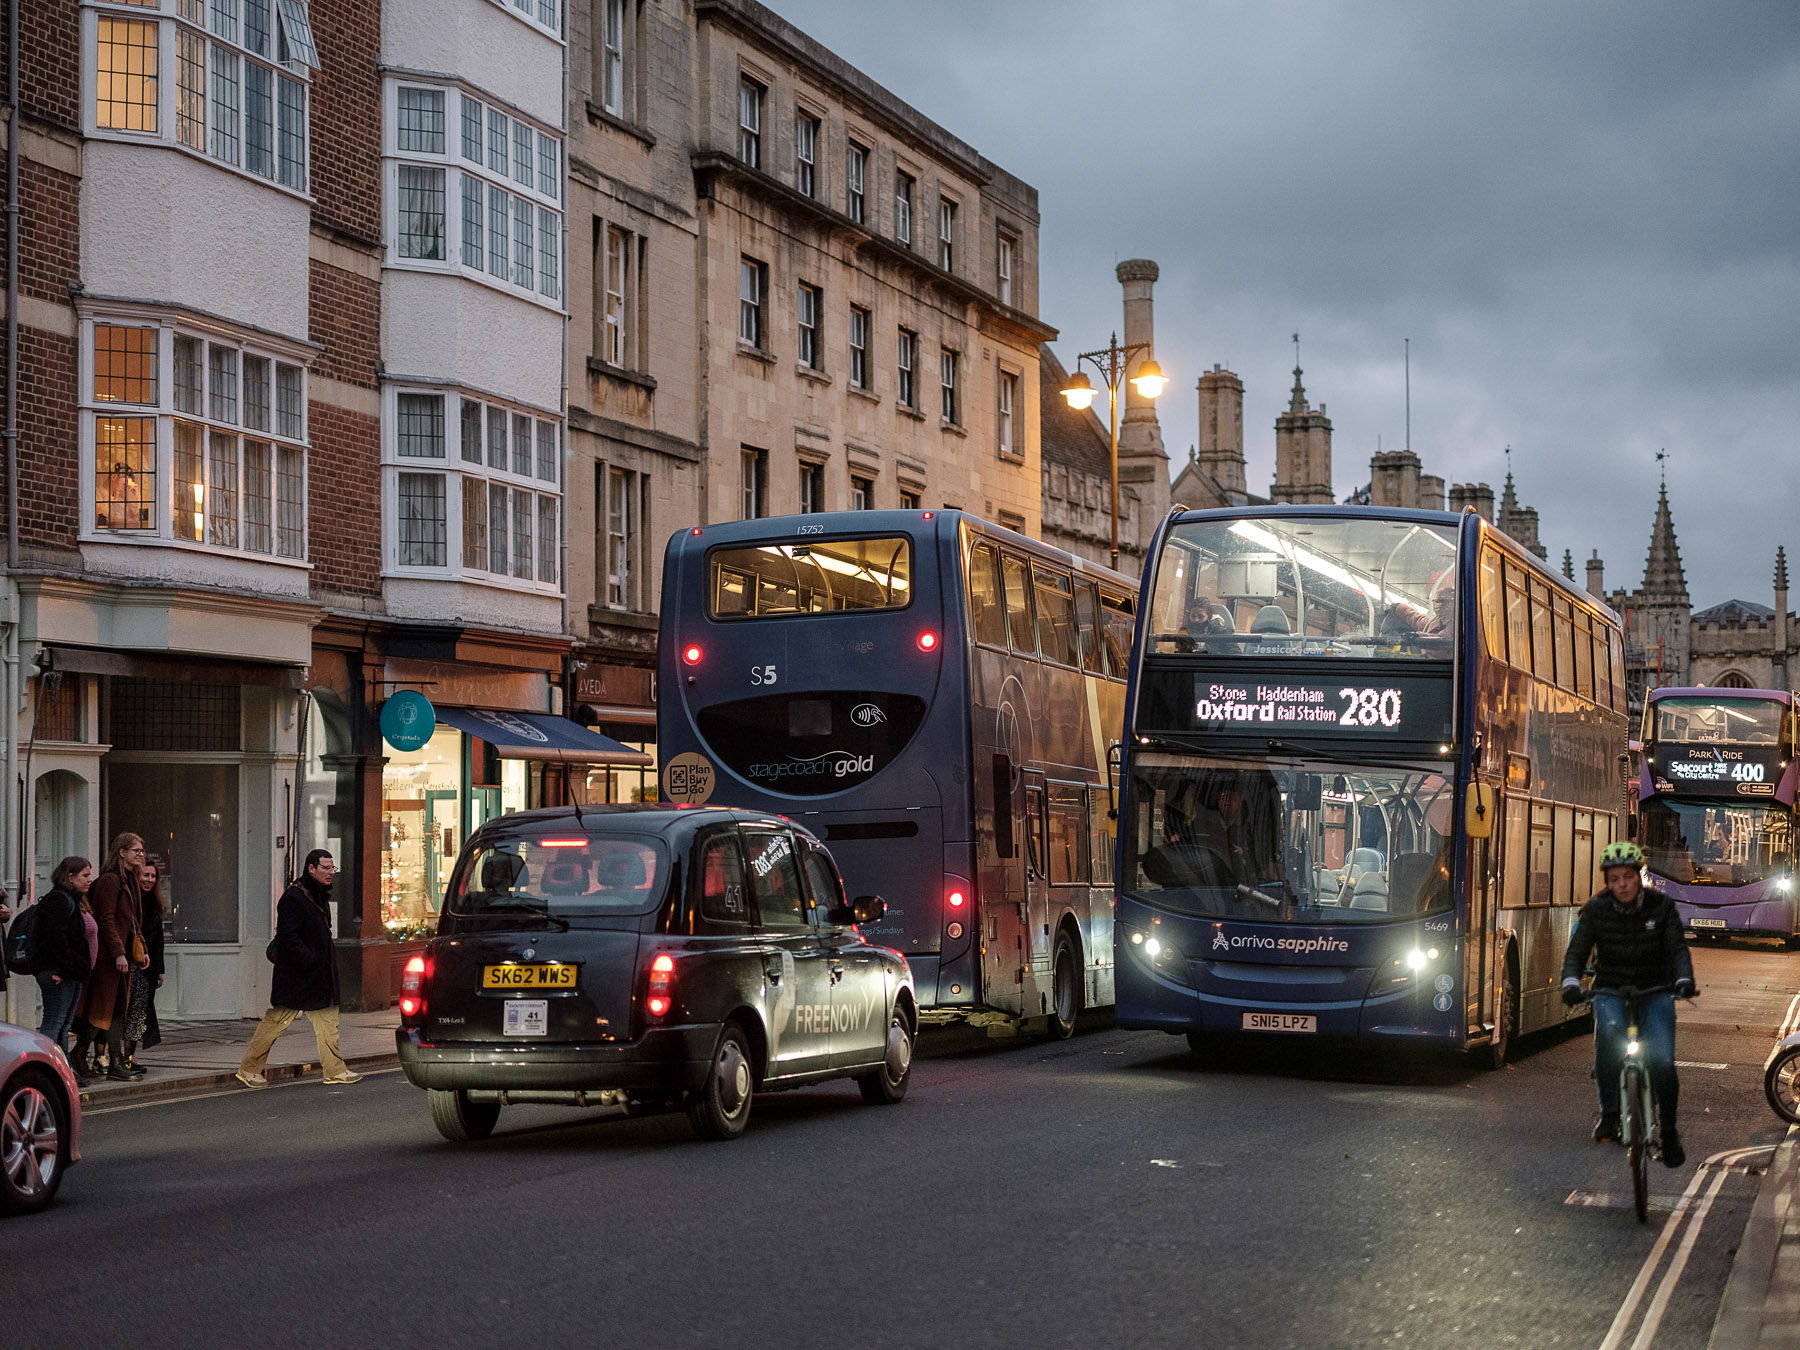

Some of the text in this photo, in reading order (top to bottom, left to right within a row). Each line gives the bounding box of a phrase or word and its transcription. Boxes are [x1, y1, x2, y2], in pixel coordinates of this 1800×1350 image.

[797, 524, 824, 535] 15752
[1254, 645, 1291, 654] Jessica
[751, 665, 777, 686] S5
[578, 679, 607, 695] AVEDA
[1209, 685, 1325, 703] Stone Haddenham
[1196, 699, 1336, 722] Oxford Rail Station
[1339, 687, 1402, 726] 280
[1689, 749, 1743, 760] PARK RIDE
[689, 764, 710, 774] Plan
[749, 755, 874, 781] stagecoach gold
[1671, 761, 1713, 773] Seacourt
[1731, 763, 1764, 782] 400
[689, 775, 708, 786] Buy
[689, 785, 705, 794] Go
[725, 885, 744, 913] 41
[1425, 922, 1448, 932] 5469
[1231, 935, 1349, 953] arriva sapphire
[491, 967, 570, 984] SK62 WWS
[1251, 1015, 1309, 1030] SN15 LPZ
